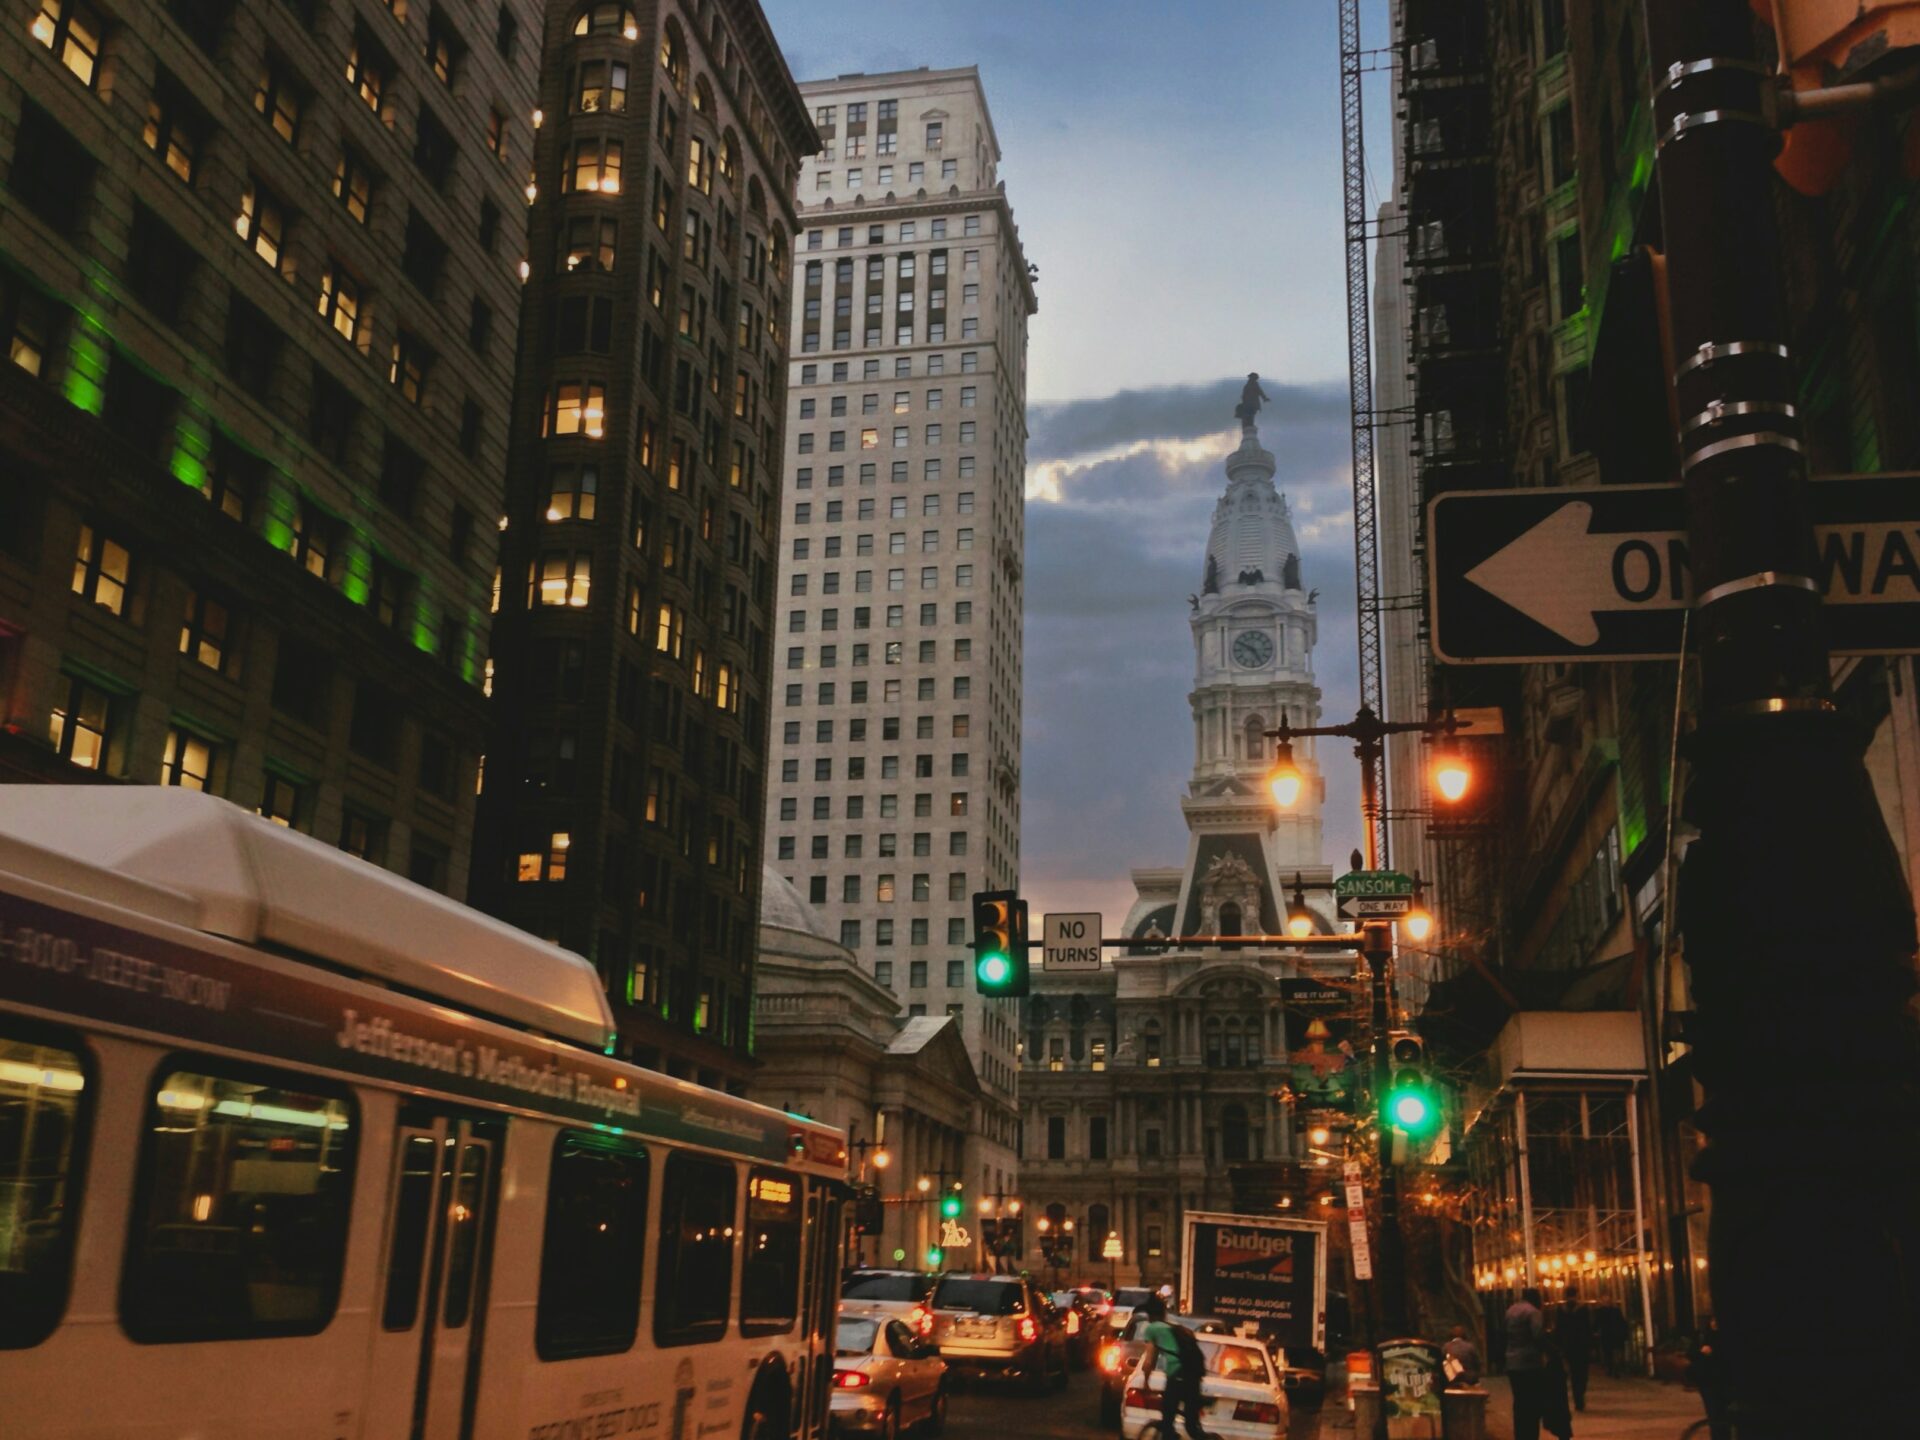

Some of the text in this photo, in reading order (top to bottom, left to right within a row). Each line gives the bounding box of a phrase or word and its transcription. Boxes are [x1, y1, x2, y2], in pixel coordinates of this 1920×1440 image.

[1612, 528, 1920, 603] ON WA
[1338, 879, 1411, 894] SANSOM ST
[1360, 902, 1405, 912] ONE WAY
[1060, 921, 1085, 939] NO
[1047, 947, 1098, 962] TURNS
[1215, 1268, 1229, 1278] Car
[1230, 1270, 1245, 1279] and
[1244, 1271, 1267, 1281] Truck
